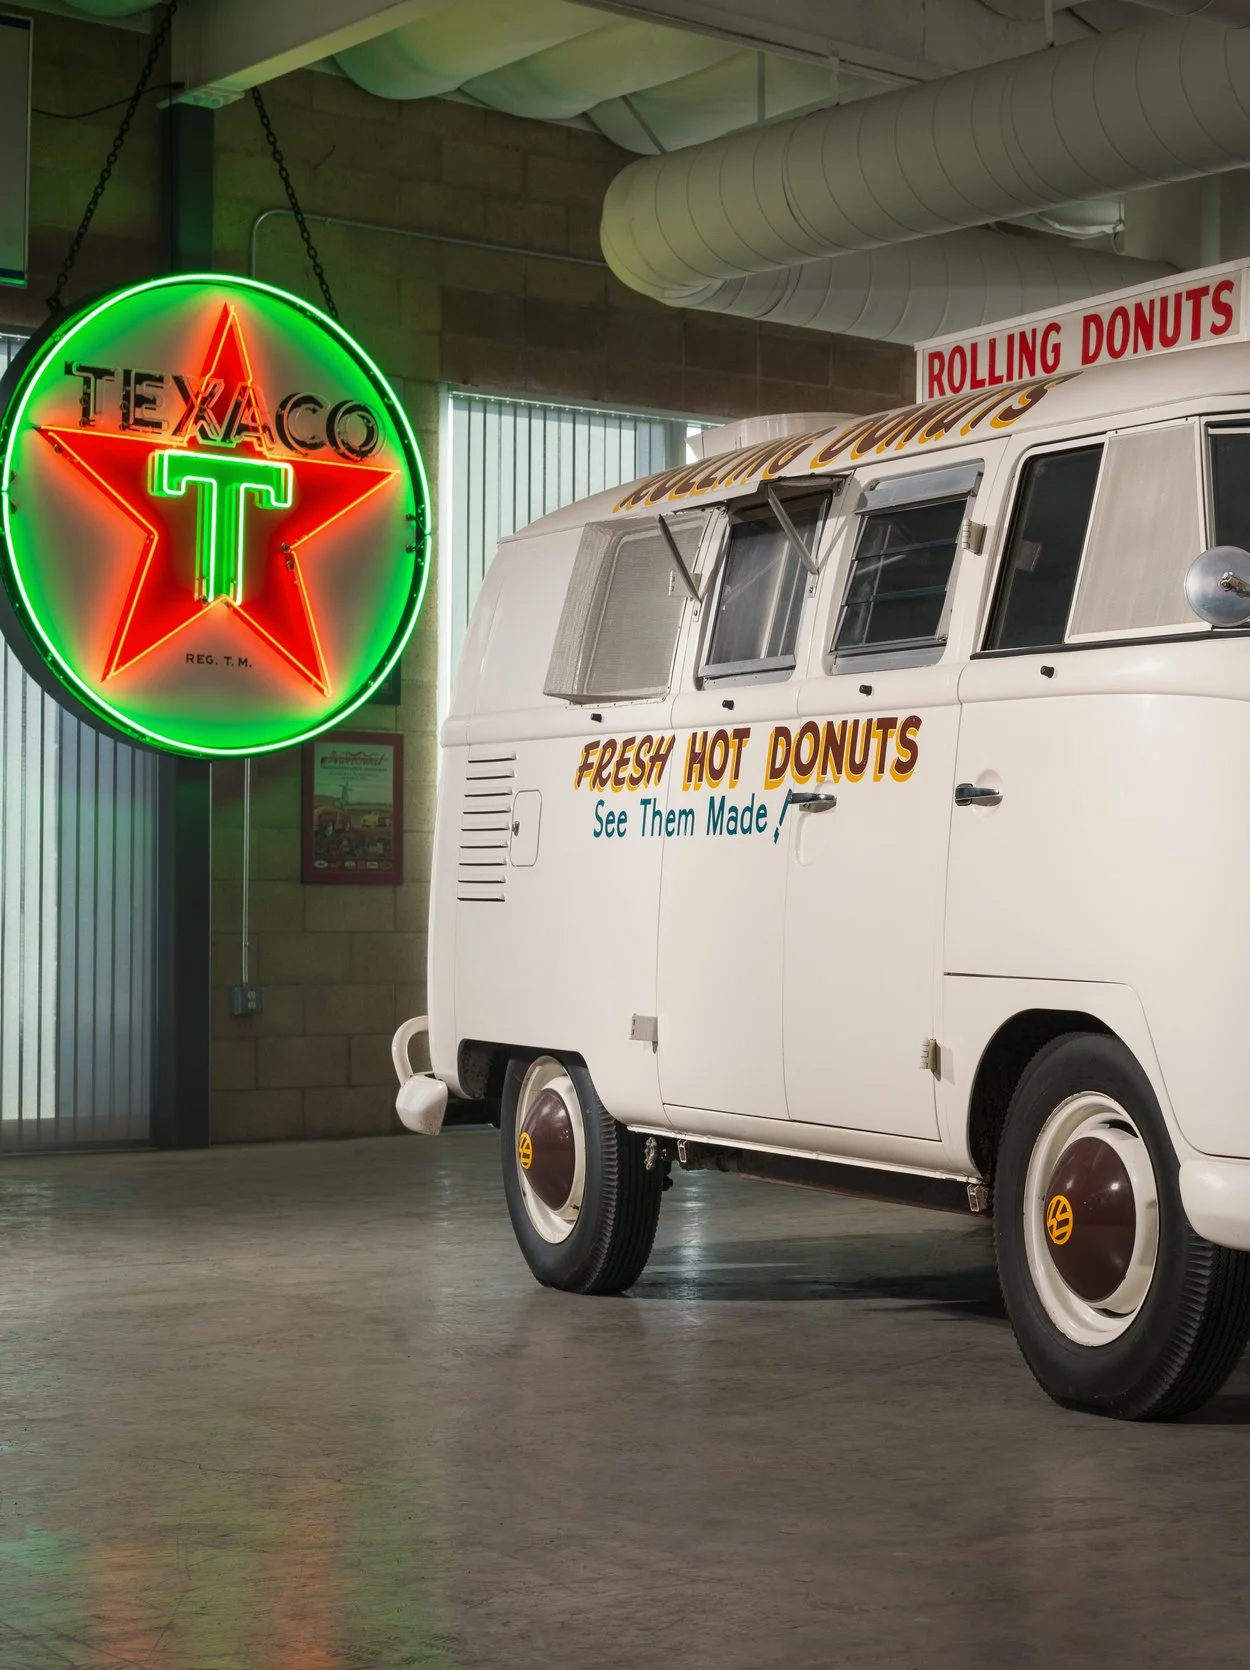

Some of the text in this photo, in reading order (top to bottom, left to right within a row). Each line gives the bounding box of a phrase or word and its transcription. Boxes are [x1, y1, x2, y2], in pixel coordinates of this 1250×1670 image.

[927, 279, 1235, 399] ROLLING DONUTS
[64, 360, 388, 461] TEXACO
[612, 372, 1083, 513] ROLLING DONUTS
[148, 449, 294, 606] T
[186, 653, 218, 665] REG.
[574, 715, 923, 792] FRESH HOT DONUTS
[593, 799, 628, 839] See
[640, 798, 695, 837] Them
